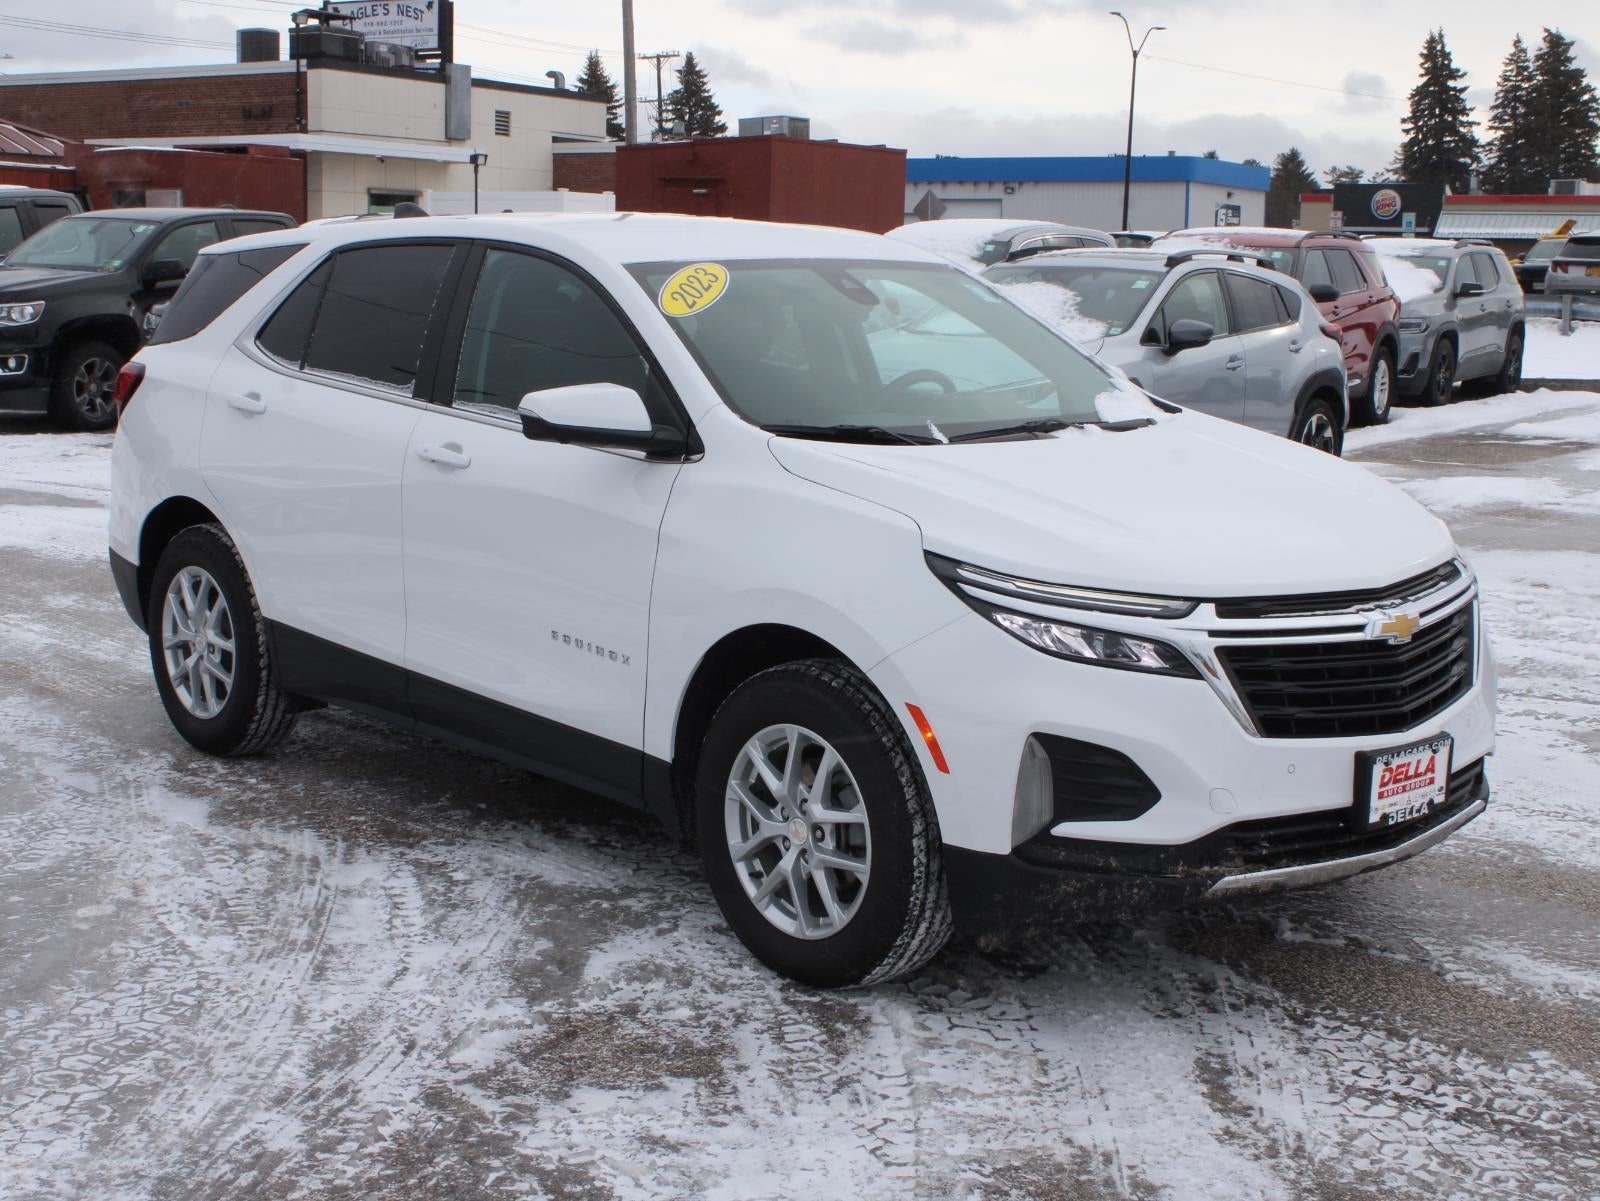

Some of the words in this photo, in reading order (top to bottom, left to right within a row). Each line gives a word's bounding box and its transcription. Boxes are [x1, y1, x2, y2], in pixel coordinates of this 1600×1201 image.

[397, 4, 425, 22] NEST
[1376, 200, 1397, 211] KING
[671, 267, 718, 309] 2023
[551, 630, 631, 666] EQUINOX
[1376, 739, 1451, 764] DELLACARS.COM
[1378, 755, 1435, 788] DELLA
[1383, 785, 1403, 797] AUTO
[1405, 778, 1430, 791] GROUP
[1388, 802, 1428, 825] DELLA
